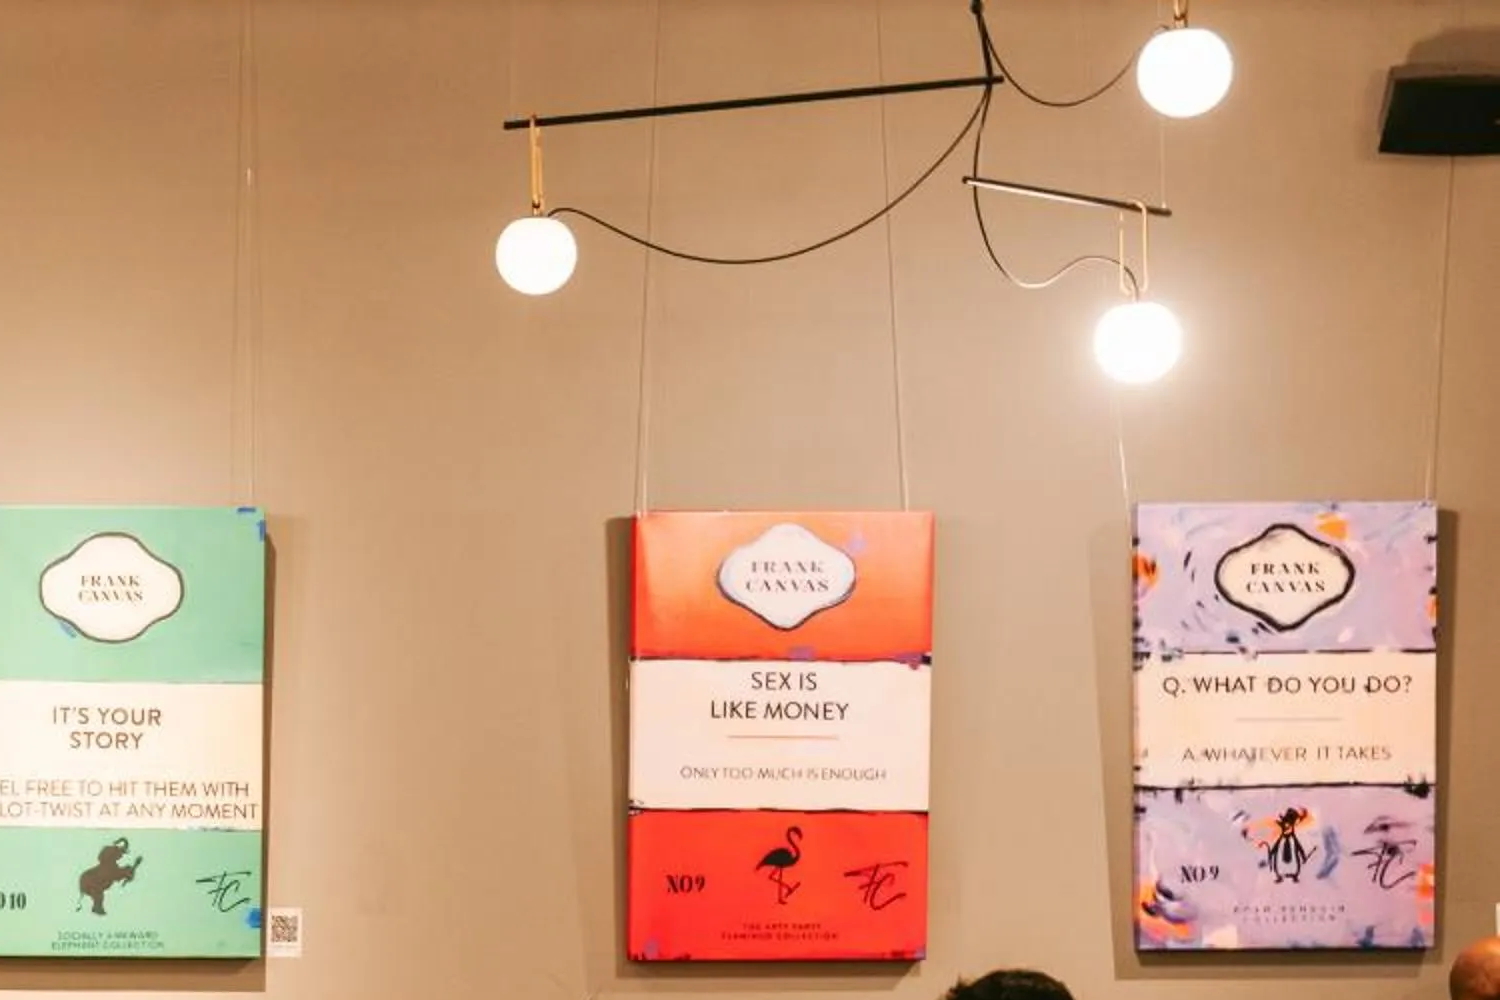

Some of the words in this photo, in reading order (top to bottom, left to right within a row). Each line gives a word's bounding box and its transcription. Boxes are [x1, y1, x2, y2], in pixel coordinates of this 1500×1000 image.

[750, 561, 825, 574] FRANK
[1250, 562, 1321, 575] FRANK
[80, 575, 141, 588] FRANK
[745, 579, 829, 593] CANVAS
[1245, 581, 1326, 593] CANVAS
[77, 590, 144, 602] CANVAS
[750, 671, 792, 691] SEX
[799, 672, 818, 691] IS
[1162, 676, 1187, 697] Q.
[1192, 676, 1257, 693] WHAT
[1267, 677, 1301, 694] DO
[1309, 676, 1356, 694] YOU
[1365, 675, 1413, 693] DO?
[52, 706, 90, 725] IT'S
[97, 708, 162, 727] YOUR
[710, 700, 757, 719] LIKE
[763, 701, 849, 721] MONEY
[68, 731, 144, 750] STORY
[1316, 747, 1330, 761] IT
[1338, 746, 1393, 761] TAKES
[679, 765, 720, 780] ONLY
[723, 766, 754, 780] TOO
[757, 767, 803, 780] MUCH
[807, 767, 819, 781] IS
[821, 767, 887, 781] ENOUGH
[25, 779, 75, 797] FREE
[77, 780, 102, 797] TO
[108, 780, 136, 797] HIT
[145, 781, 198, 798] THEM
[202, 781, 250, 798] WITH
[100, 802, 121, 819] AT
[126, 802, 165, 820] ANY
[171, 803, 259, 821] MOMENT
